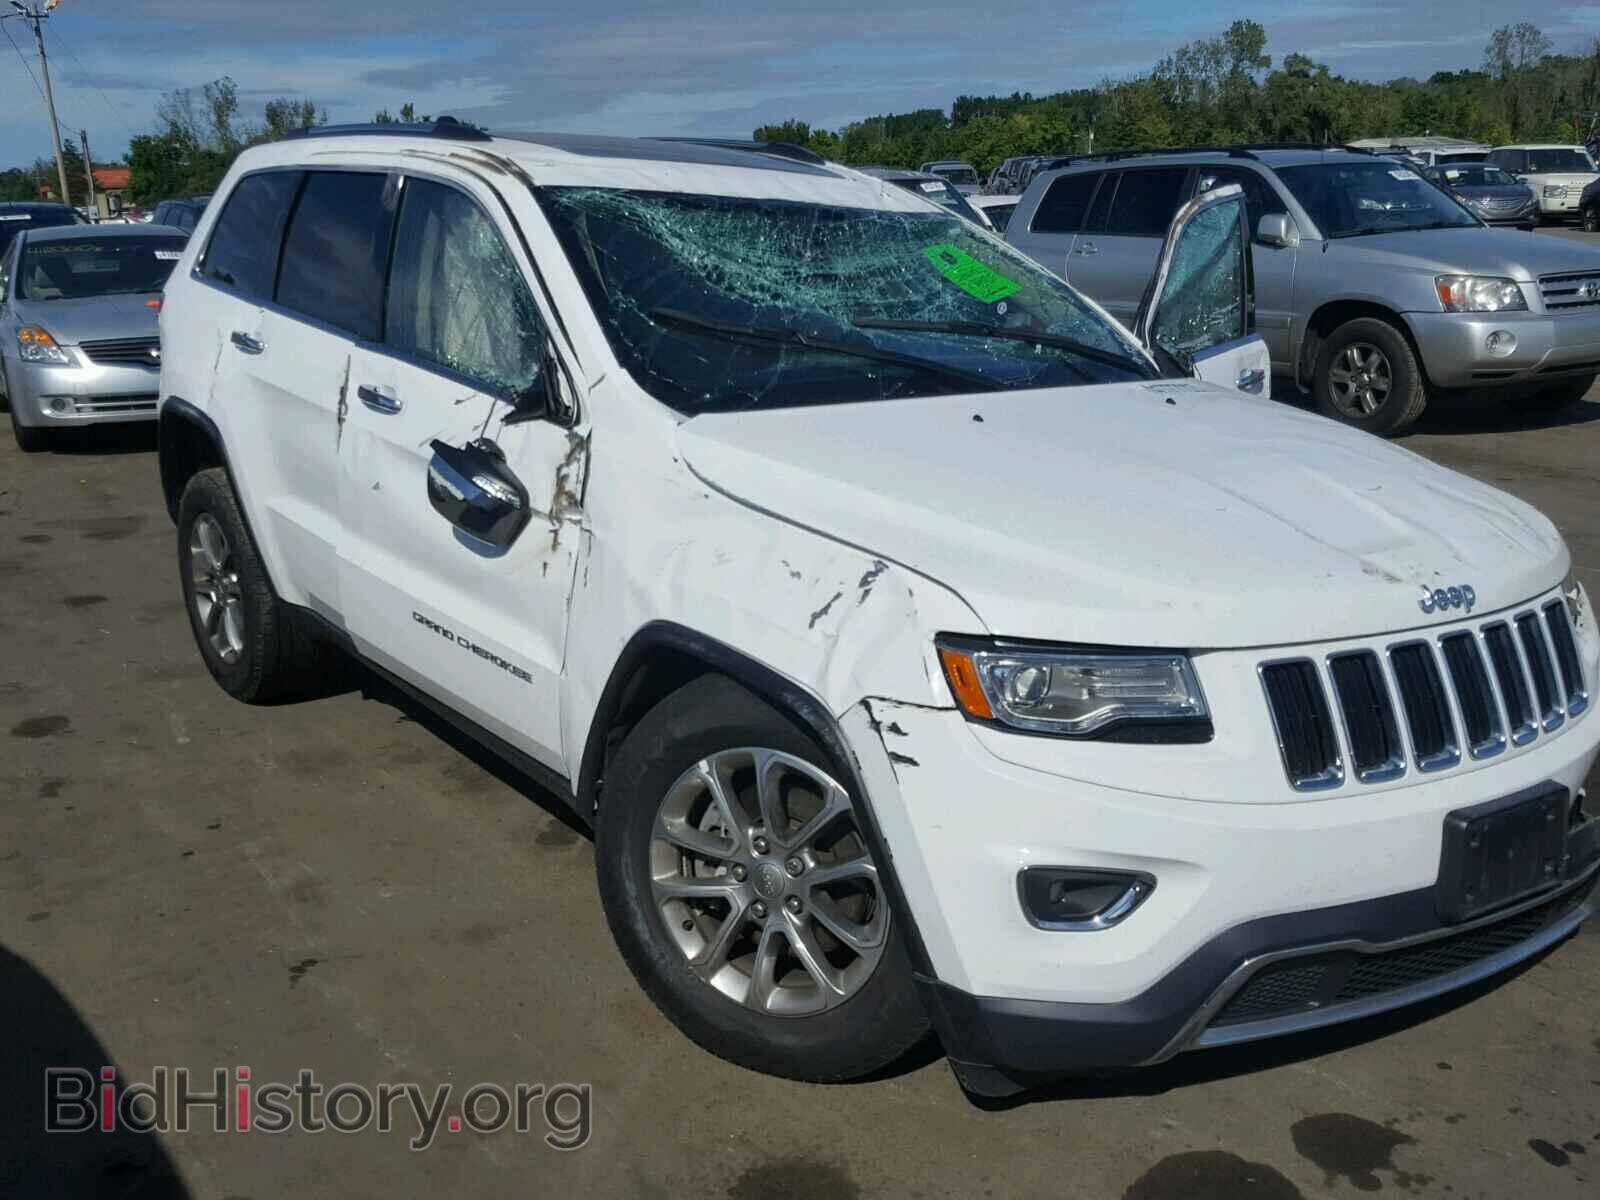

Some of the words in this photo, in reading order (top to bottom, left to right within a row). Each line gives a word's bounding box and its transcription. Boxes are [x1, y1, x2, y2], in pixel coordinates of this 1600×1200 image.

[1418, 584, 1475, 614] Jeep
[412, 611, 454, 641] GRAND
[457, 636, 533, 684] CHEROKEE
